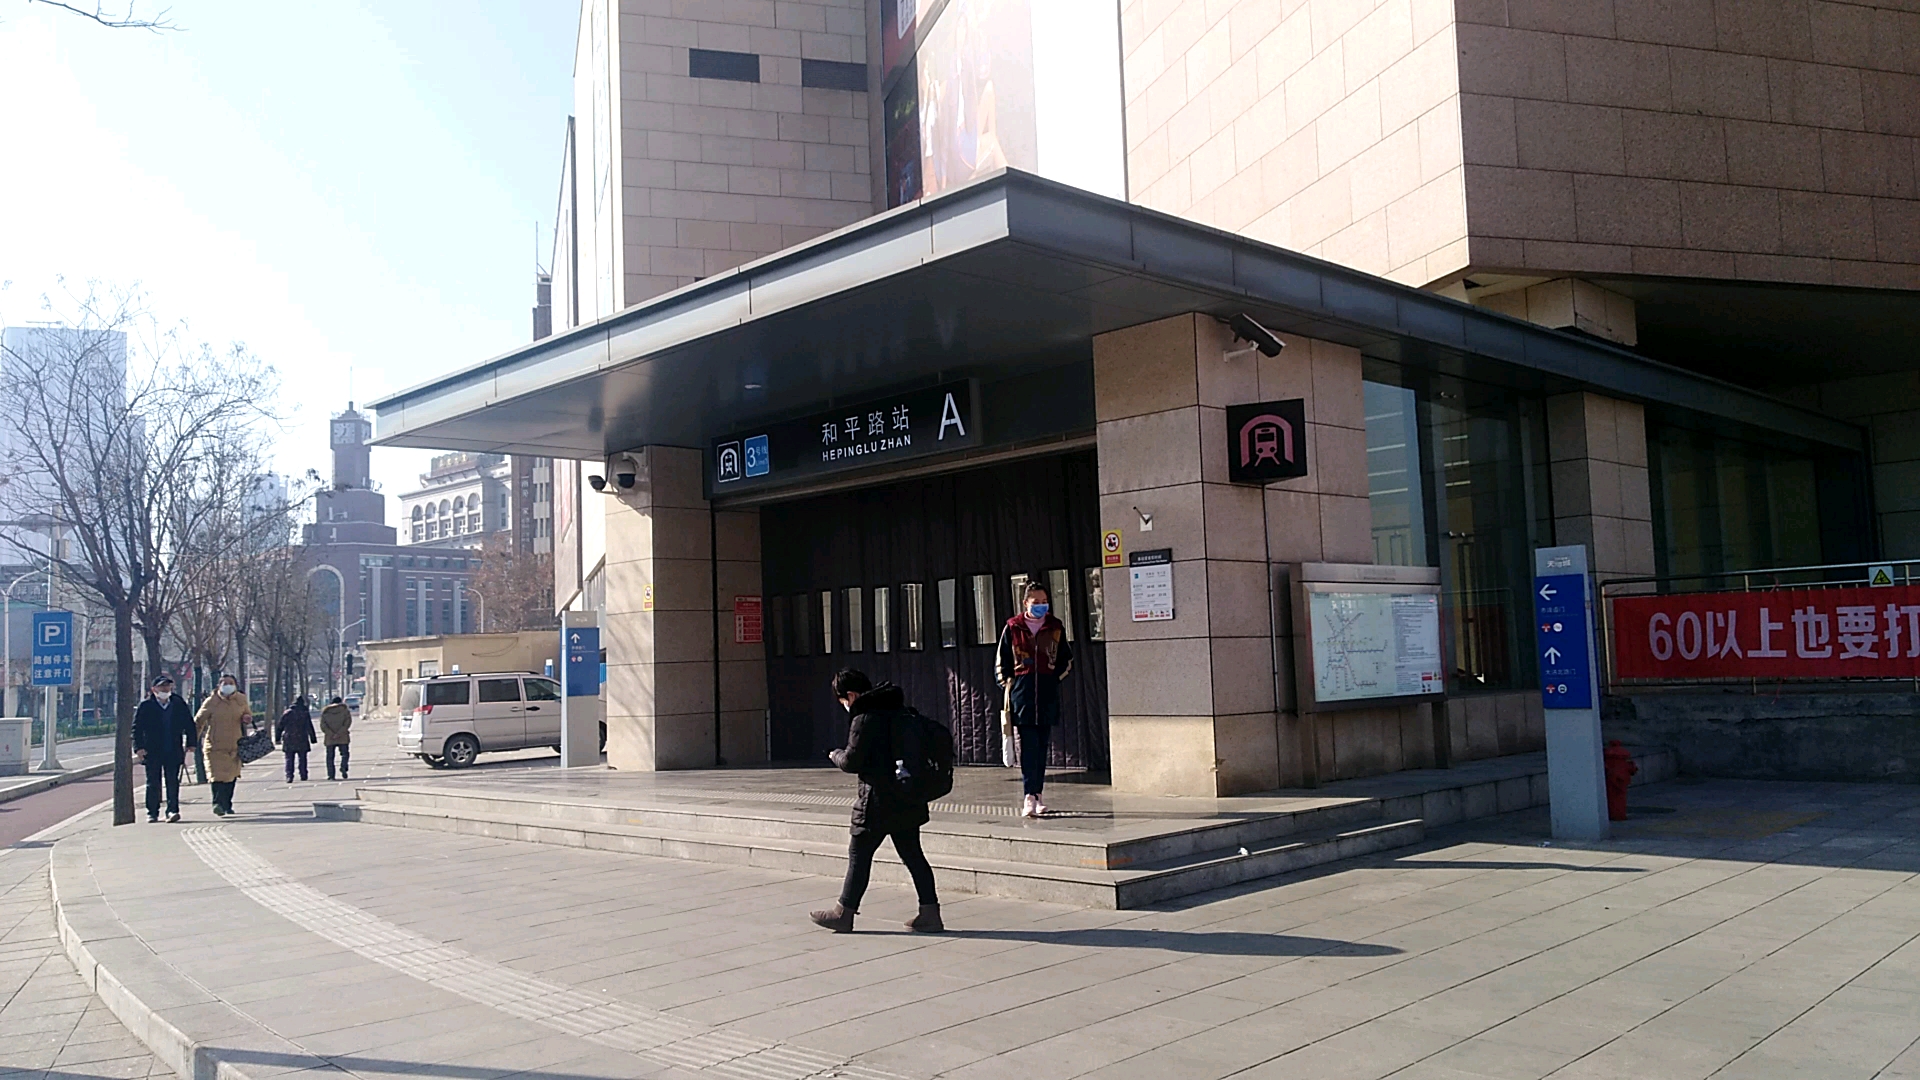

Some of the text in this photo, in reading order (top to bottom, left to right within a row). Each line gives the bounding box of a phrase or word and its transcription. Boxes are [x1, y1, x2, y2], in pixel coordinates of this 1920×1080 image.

[821, 403, 910, 446] 和平路站
[938, 392, 966, 441] A
[747, 446, 756, 468] 3
[44, 625, 61, 643] P
[1648, 603, 1920, 661] 60以上也要打
[34, 668, 71, 679] 注意开门
